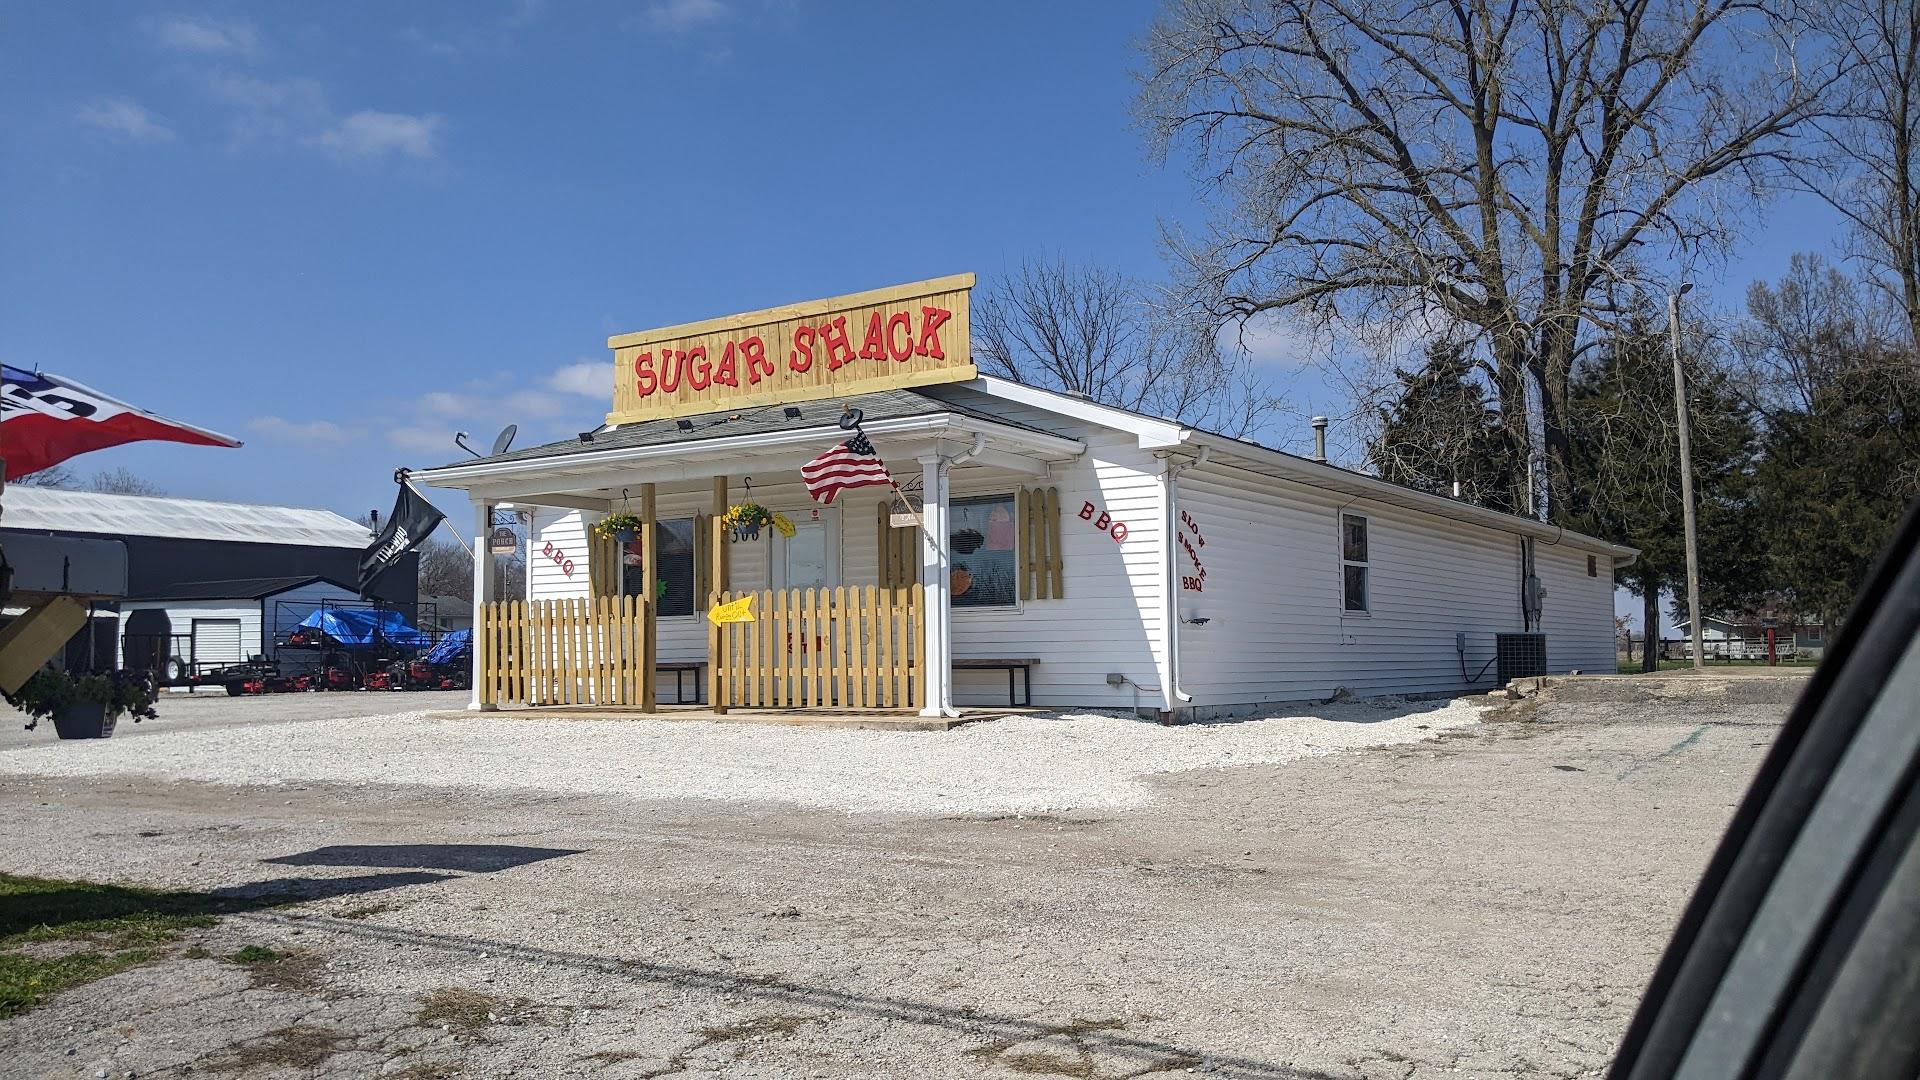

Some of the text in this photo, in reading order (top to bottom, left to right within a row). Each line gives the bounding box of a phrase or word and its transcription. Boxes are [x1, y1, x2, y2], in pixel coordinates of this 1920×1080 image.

[635, 306, 951, 398] SUGAR SHACK
[1078, 501, 1128, 544] BBQ
[1181, 510, 1205, 547] SLOW
[542, 541, 575, 577] BBQ
[1178, 531, 1206, 581] SMOKE
[1182, 576, 1203, 592] BBQ
